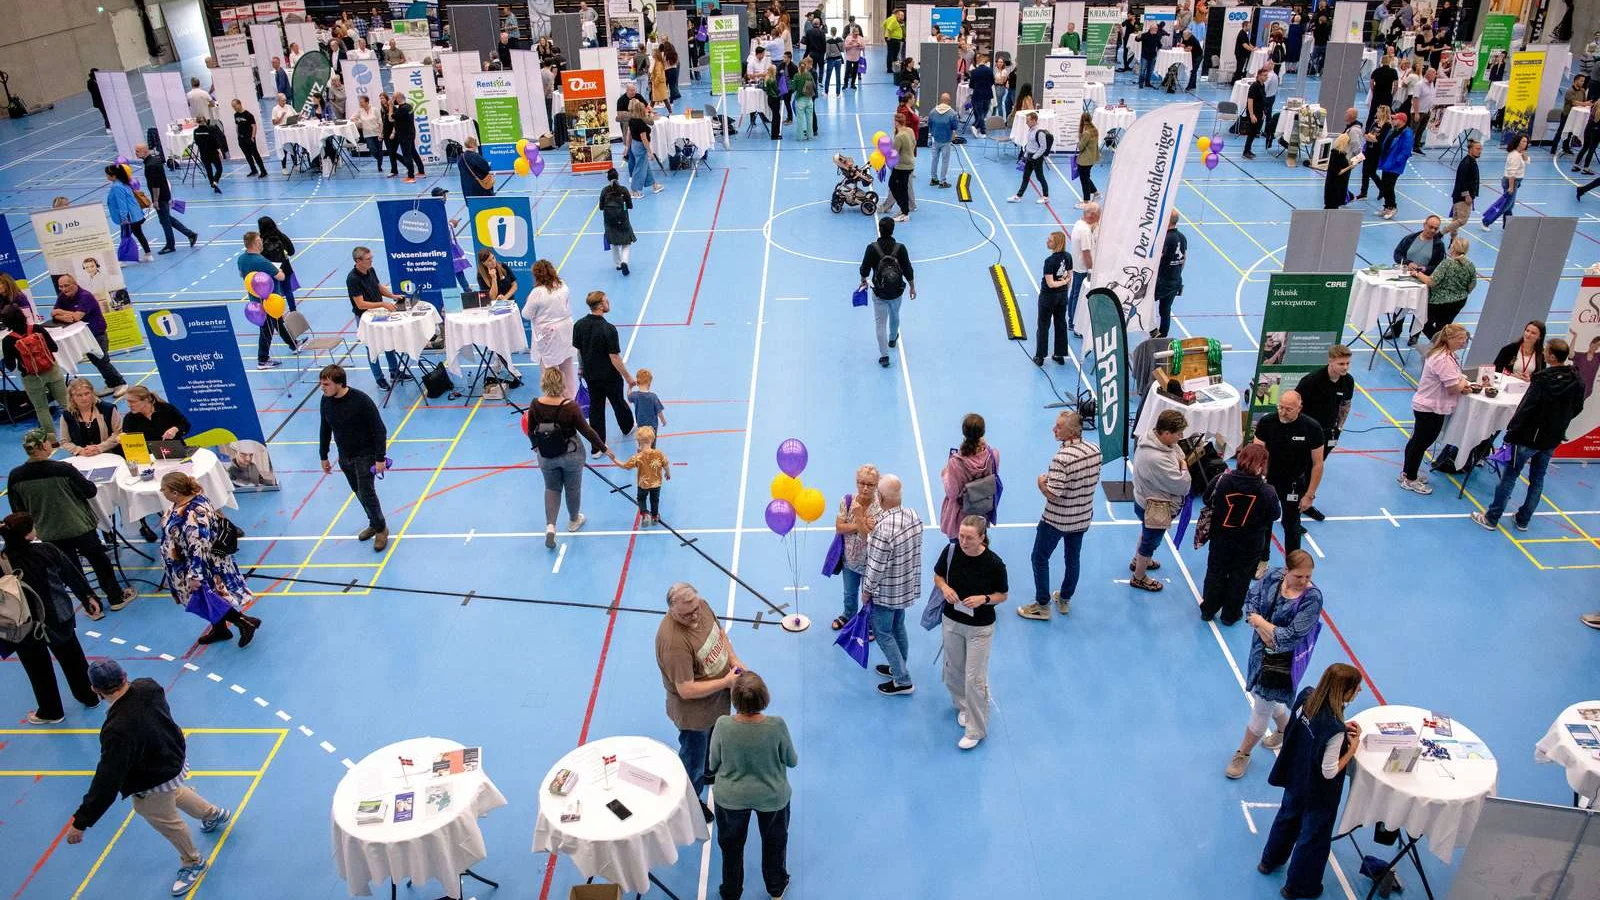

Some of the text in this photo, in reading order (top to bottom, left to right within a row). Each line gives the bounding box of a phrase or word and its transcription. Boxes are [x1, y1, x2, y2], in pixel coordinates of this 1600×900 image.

[1133, 122, 1175, 260] Der Nordschleswiger
[391, 250, 447, 260] Voksenlærling
[1272, 288, 1298, 297] Teknisk
[1271, 299, 1317, 307] servicepartner
[188, 319, 226, 328] jobcenter
[171, 351, 223, 363] Overvejer du
[185, 363, 199, 373] nyt
[1095, 325, 1119, 436] CBRE
